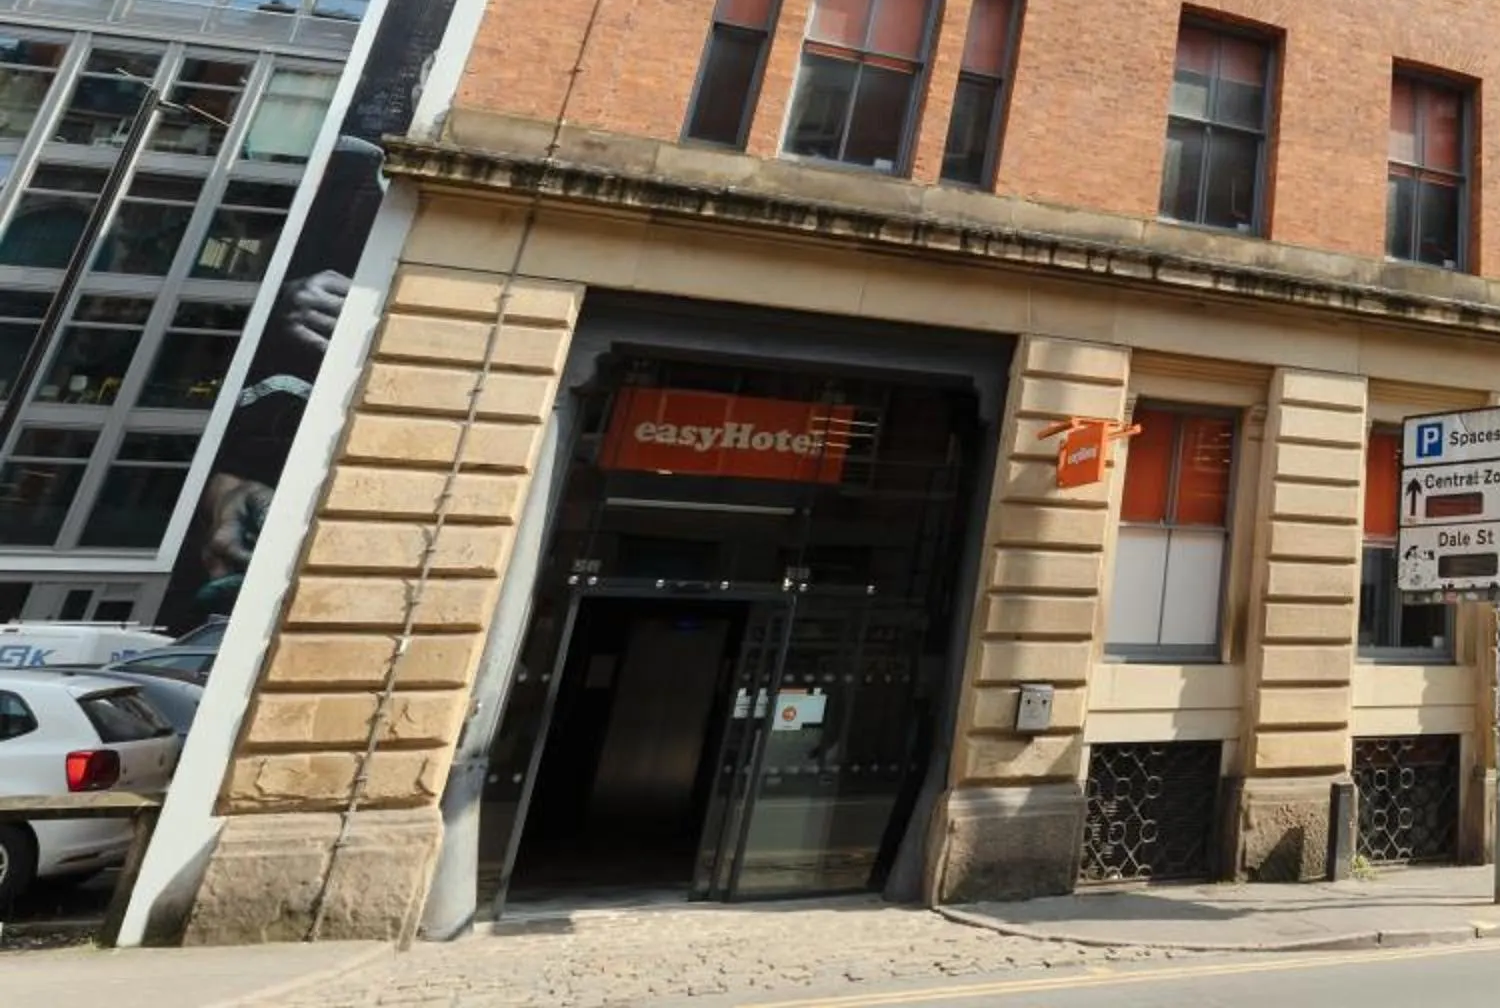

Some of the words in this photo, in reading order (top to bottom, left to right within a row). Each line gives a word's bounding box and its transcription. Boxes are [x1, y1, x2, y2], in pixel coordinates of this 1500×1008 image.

[634, 421, 824, 456] easyHotel
[1422, 427, 1439, 455] P
[1425, 471, 1479, 490] Central
[1438, 532, 1471, 548] Dale
[1476, 529, 1495, 545] St
